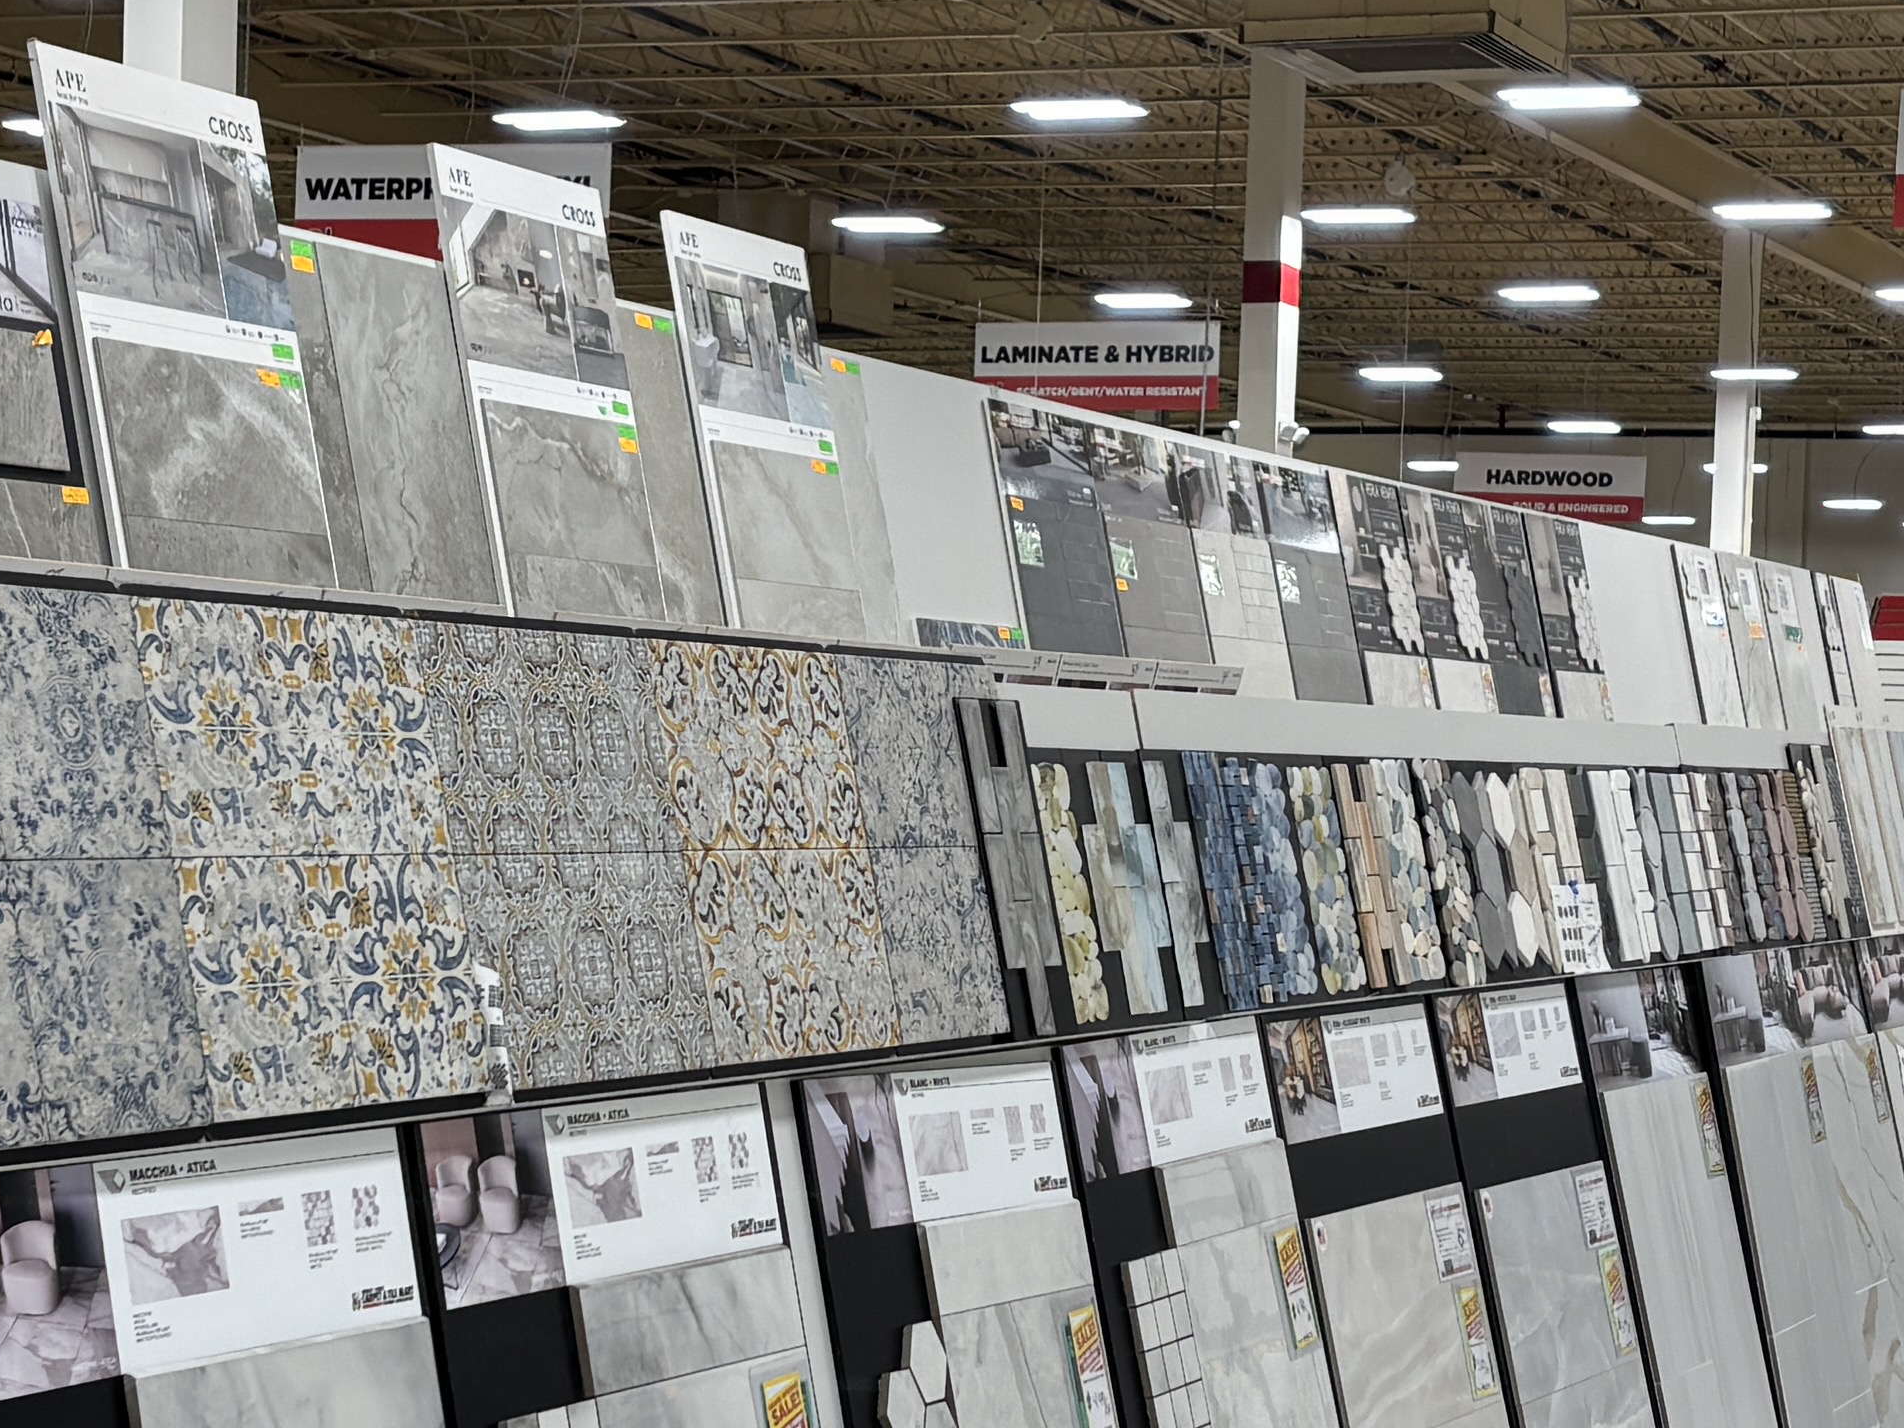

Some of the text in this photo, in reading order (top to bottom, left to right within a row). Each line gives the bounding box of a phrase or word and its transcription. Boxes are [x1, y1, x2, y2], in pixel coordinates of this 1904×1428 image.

[208, 115, 253, 144] CROSS
[305, 177, 433, 201] WATERP
[561, 203, 596, 228] CROSS
[980, 344, 1215, 364] LAMINATE & HYBRID
[1486, 468, 1614, 488] HARDWOOD
[1557, 502, 1629, 515] ENGINEERED
[129, 1159, 217, 1182] MACCHIA ATICA
